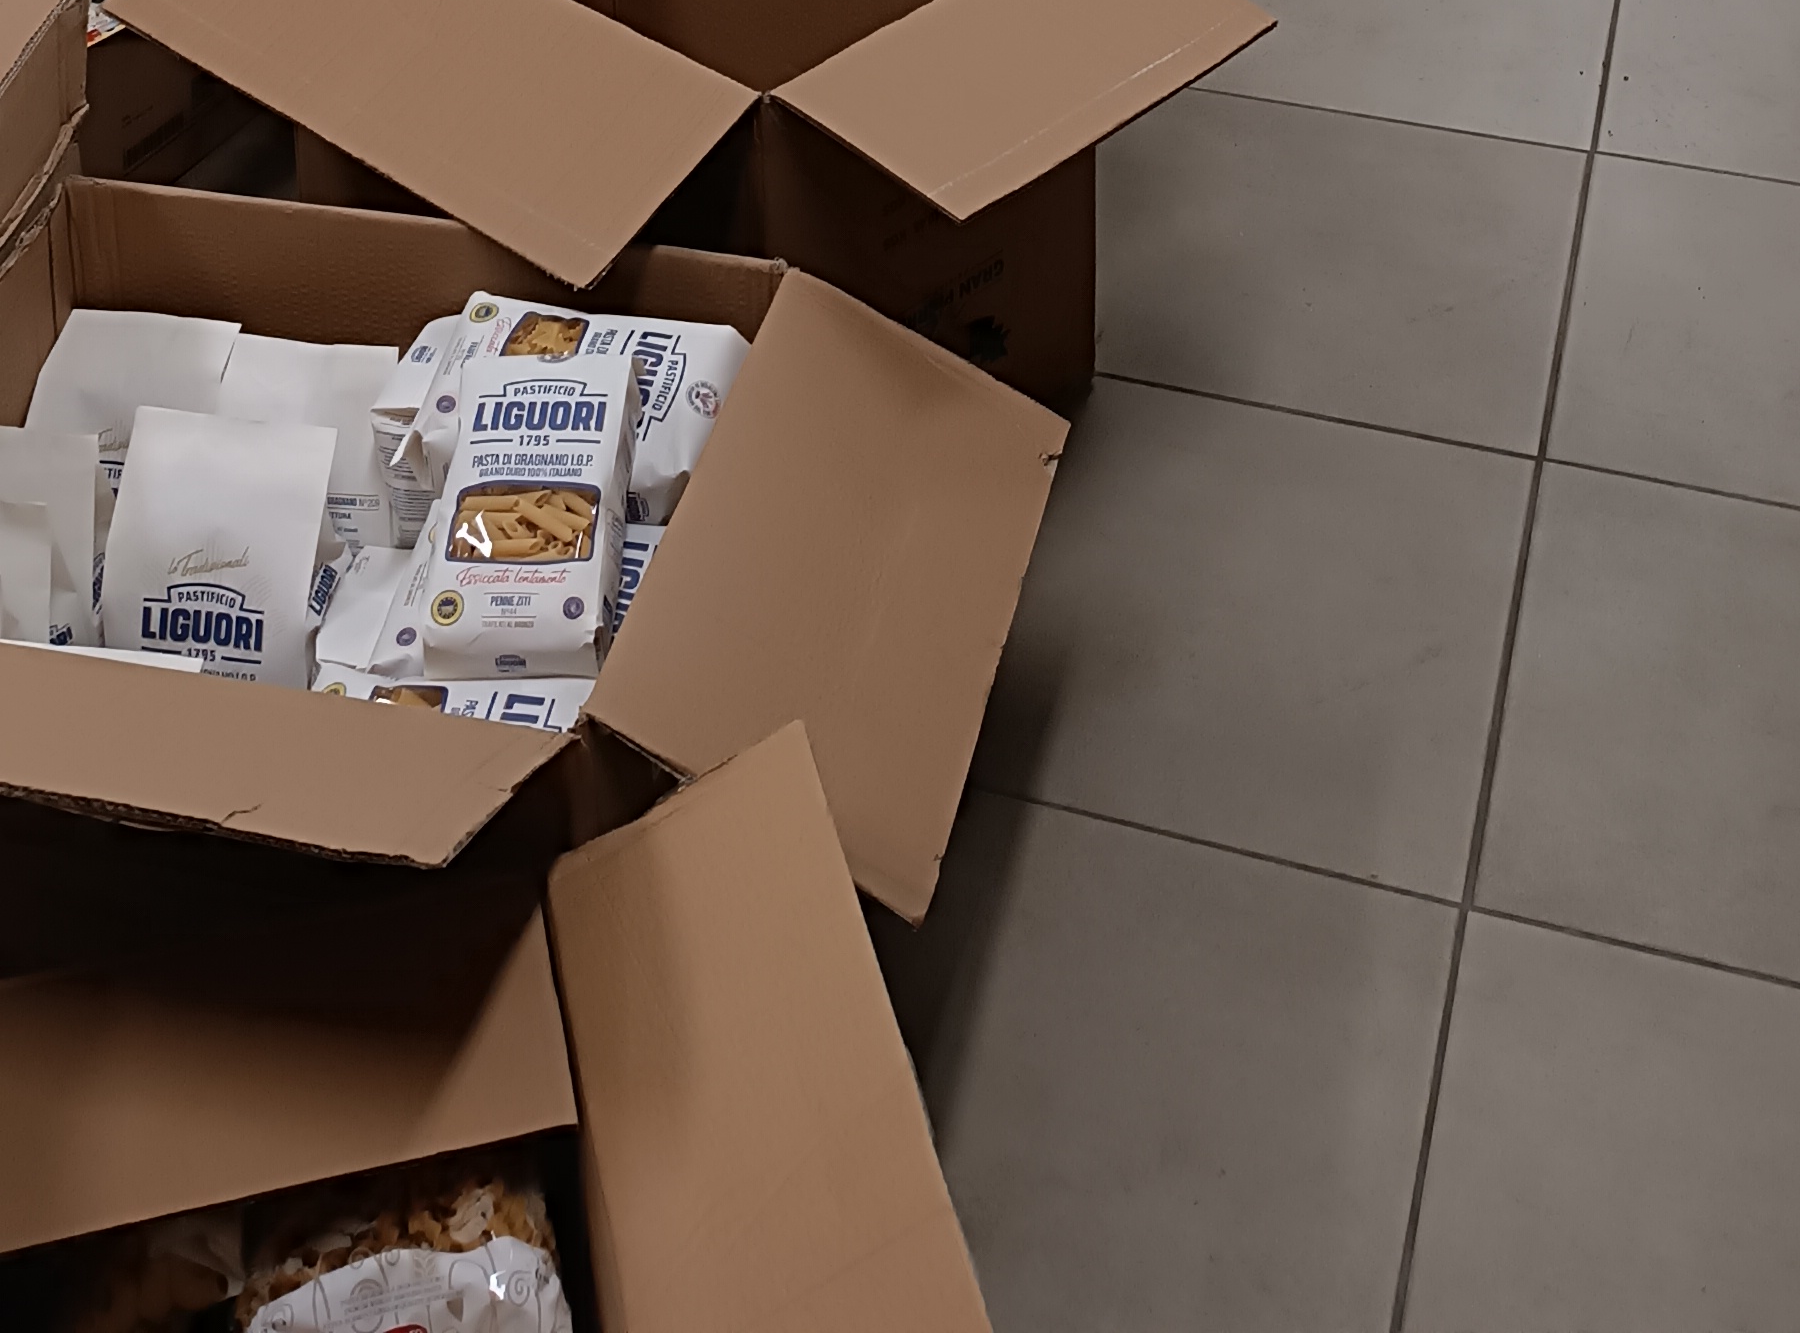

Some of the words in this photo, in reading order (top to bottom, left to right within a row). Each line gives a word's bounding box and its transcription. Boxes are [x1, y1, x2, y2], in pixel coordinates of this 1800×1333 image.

[513, 385, 576, 397] PASTIFICIO
[651, 359, 679, 412] PASTIFICIO
[472, 400, 607, 432] LIGUORI
[518, 435, 551, 446] 1795
[472, 454, 500, 468] PASTA
[502, 453, 513, 466] DI
[514, 453, 569, 466] GRAGNANO
[479, 467, 504, 477] GRANO
[505, 468, 526, 477] DURO
[527, 468, 548, 477] 100%
[549, 468, 583, 477] ITALIANO
[309, 564, 339, 616] LIGUORI
[177, 590, 236, 609] PASTIFICIO
[490, 595, 516, 606] PENNE
[515, 595, 531, 606] ZITI
[141, 606, 264, 652] LIGUORI
[186, 647, 217, 662] 1795
